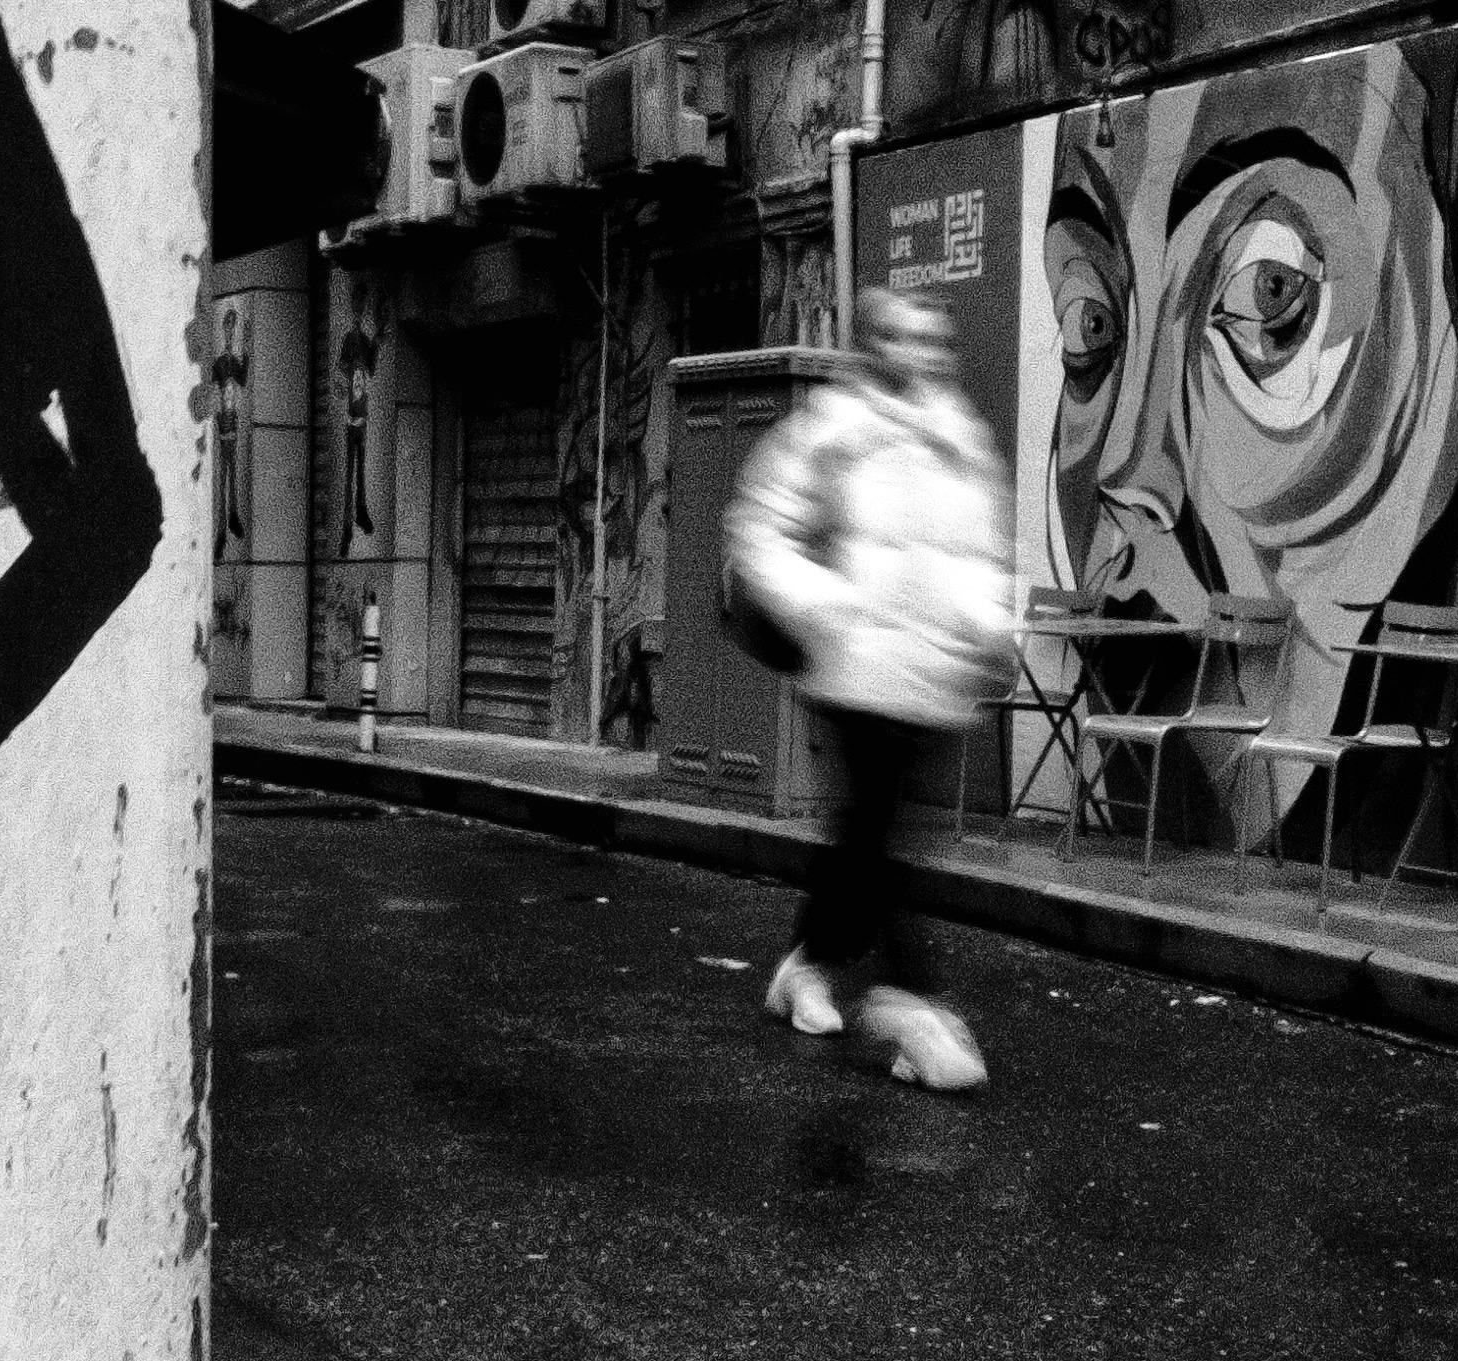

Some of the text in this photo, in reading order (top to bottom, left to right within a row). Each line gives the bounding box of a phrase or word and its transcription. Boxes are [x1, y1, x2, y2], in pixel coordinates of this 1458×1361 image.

[889, 198, 940, 229] WOMAN
[889, 235, 913, 261] LIFE
[888, 262, 945, 291] FREEDOM
